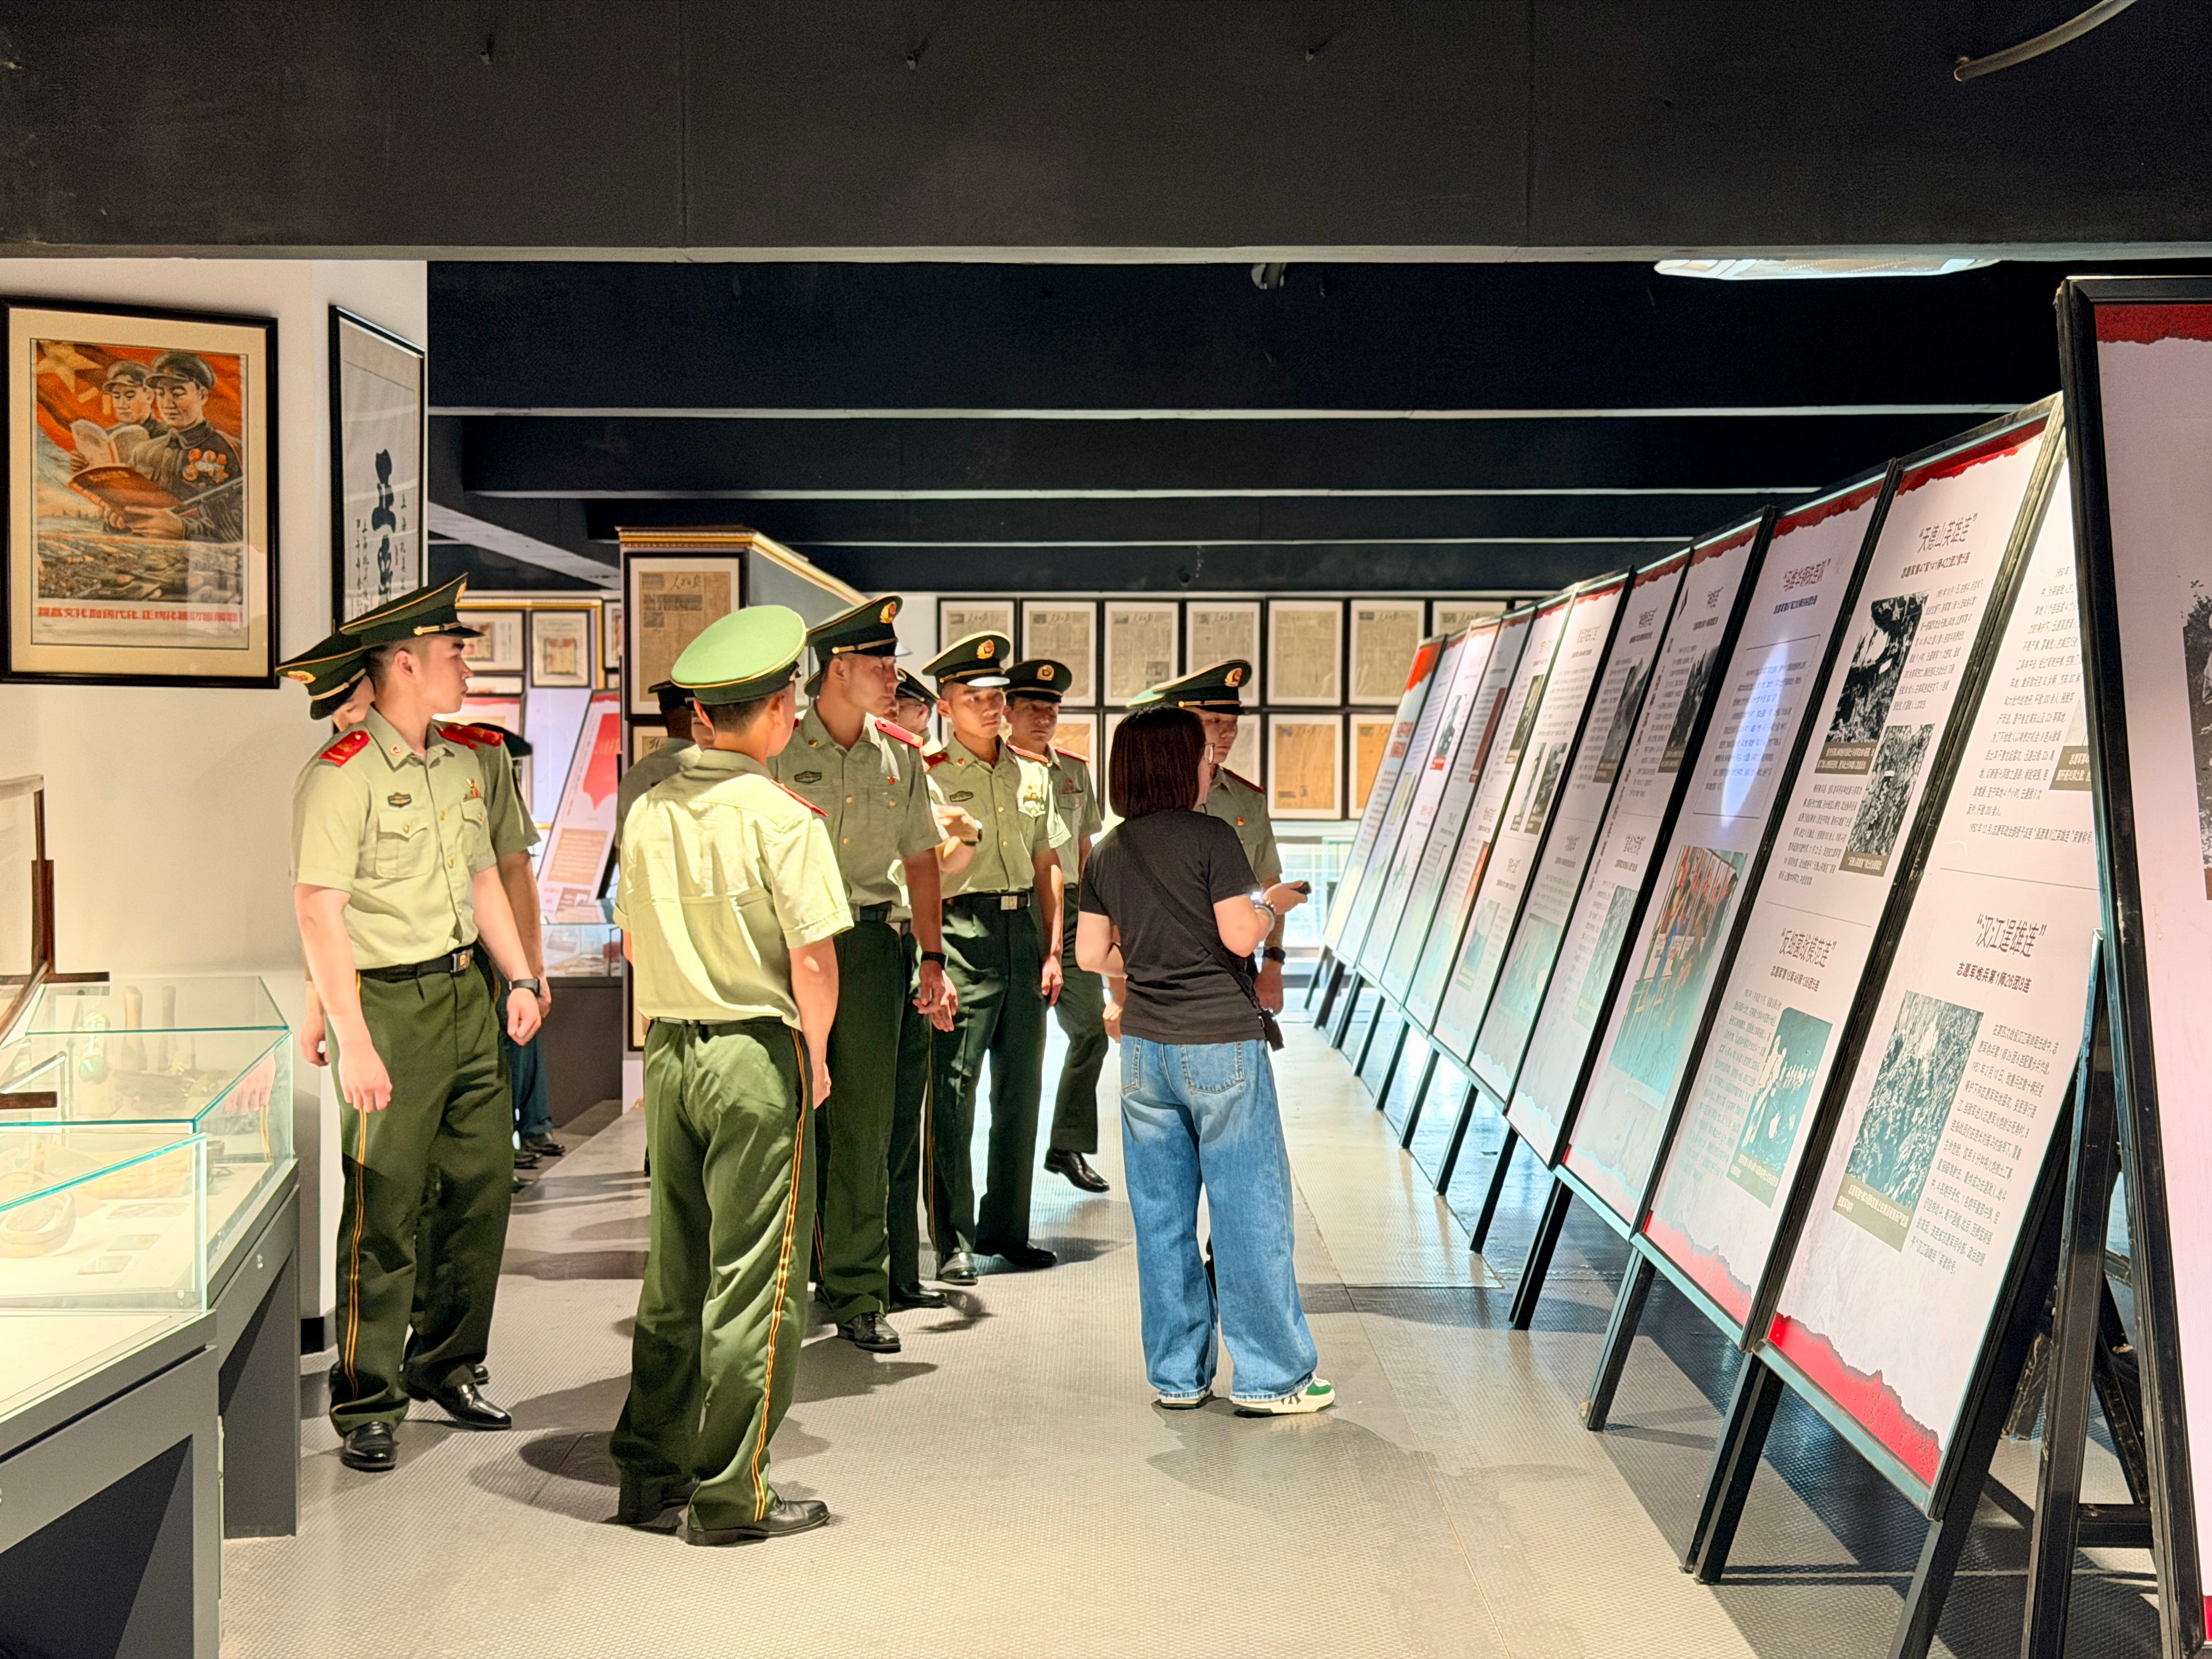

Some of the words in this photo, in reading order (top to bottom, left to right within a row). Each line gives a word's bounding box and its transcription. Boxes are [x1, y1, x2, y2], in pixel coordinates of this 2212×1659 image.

[1917, 513, 1978, 554] “天德山英雄连”
[1779, 928, 1837, 967] “反细菌战模范连”
[1956, 962, 2032, 993] 志愿军炮兵第1师26团8连
